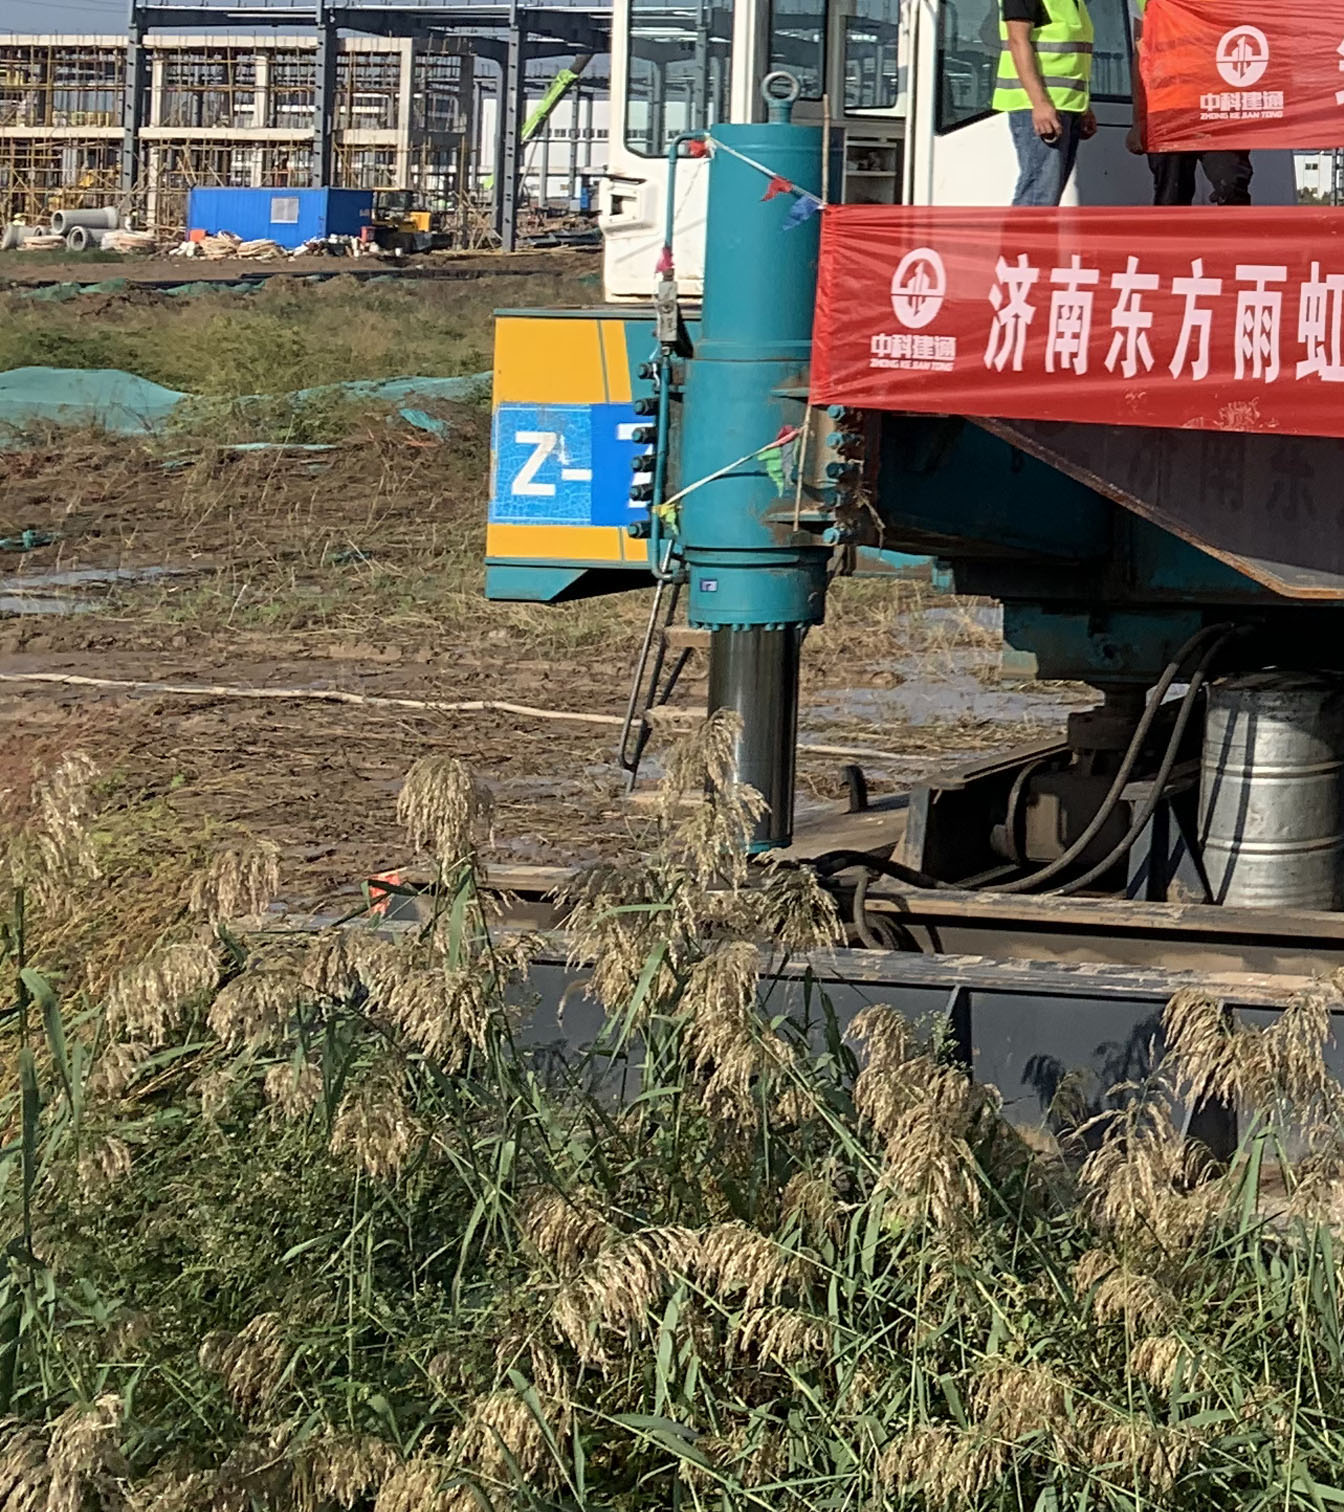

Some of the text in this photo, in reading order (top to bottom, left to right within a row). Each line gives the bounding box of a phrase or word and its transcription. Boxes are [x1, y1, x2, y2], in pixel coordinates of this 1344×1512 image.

[1199, 90, 1284, 112] 中科建通
[870, 333, 957, 361] 中科建通
